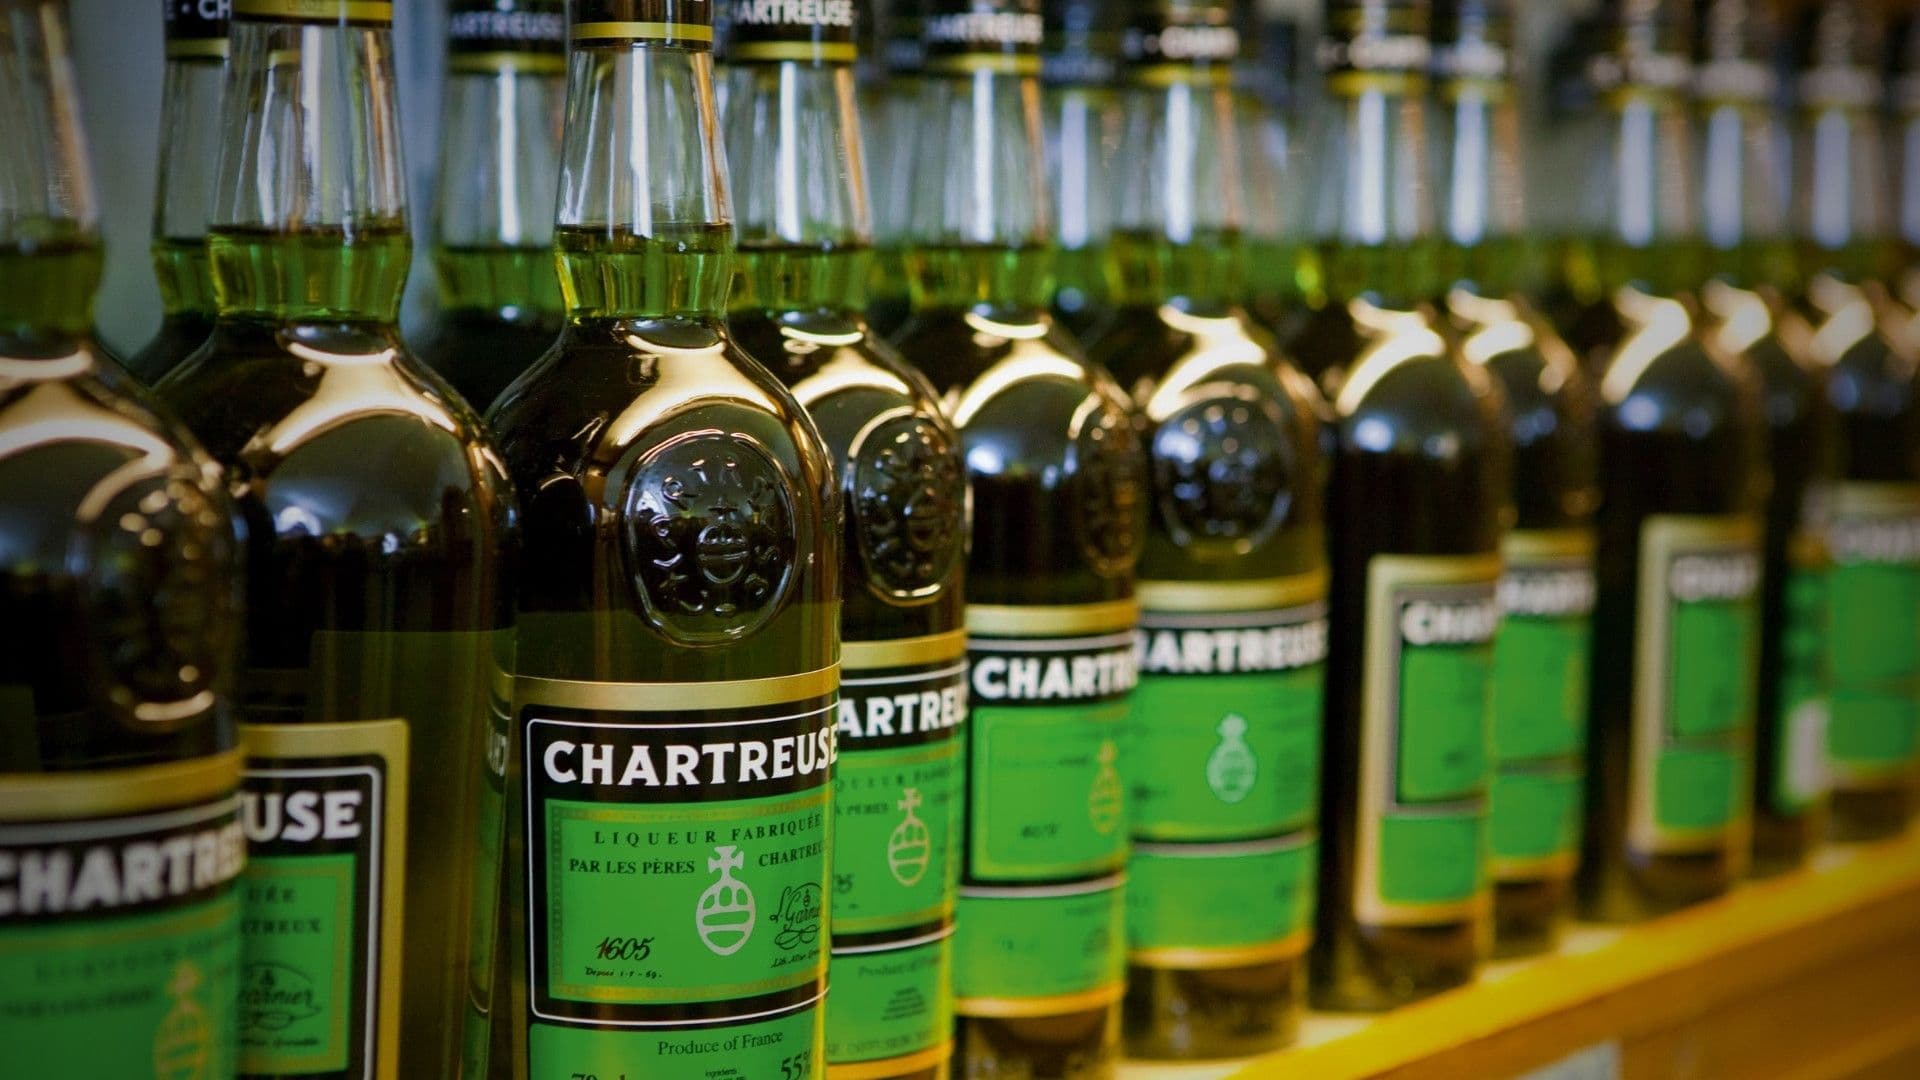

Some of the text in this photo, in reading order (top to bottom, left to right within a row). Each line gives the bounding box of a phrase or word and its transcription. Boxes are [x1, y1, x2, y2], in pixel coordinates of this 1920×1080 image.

[543, 723, 838, 787] CHARTREUSE
[594, 813, 821, 847] LIQUEUR FABRIQUÉE
[569, 856, 696, 874] PAR LES PÈRES
[595, 936, 655, 961] 1605
[657, 1030, 784, 1056] Produce of France
